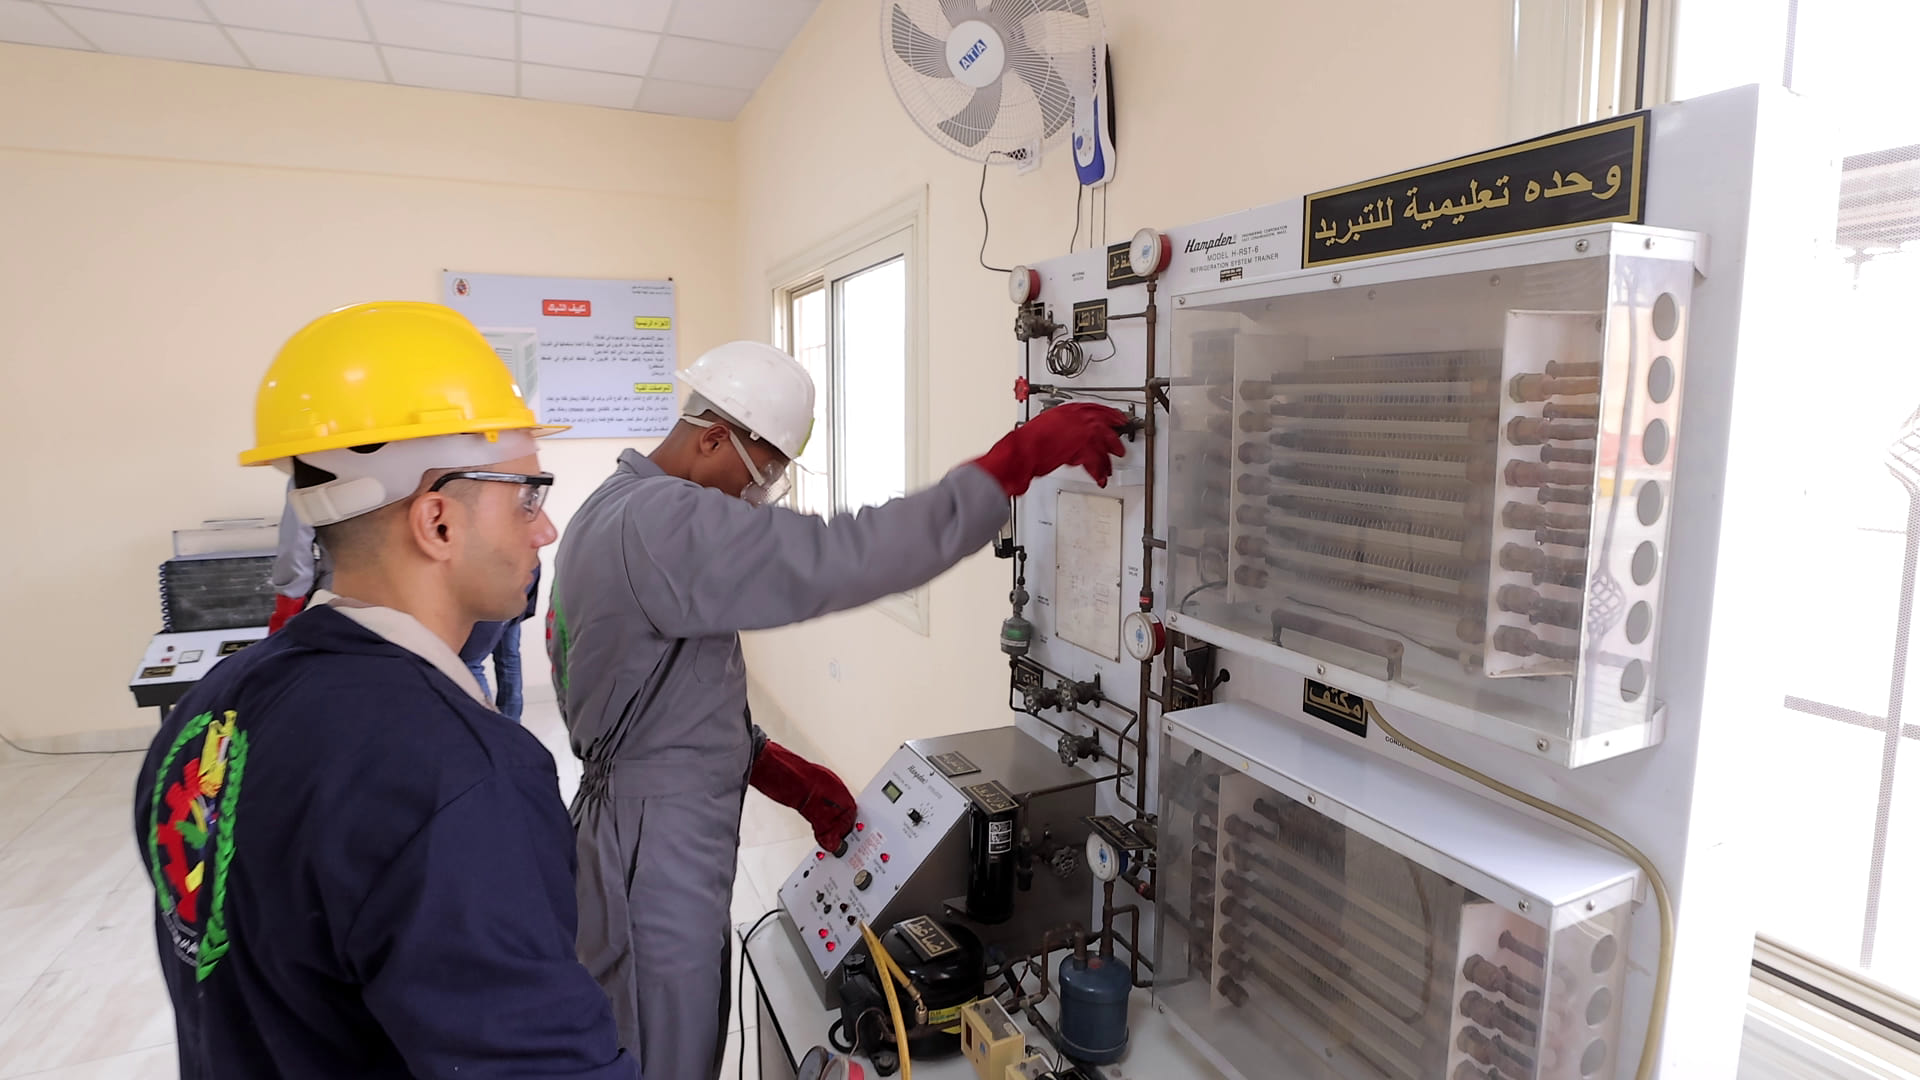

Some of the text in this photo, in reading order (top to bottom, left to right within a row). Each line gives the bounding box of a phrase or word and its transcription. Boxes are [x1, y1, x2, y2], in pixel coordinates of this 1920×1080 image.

[959, 39, 988, 71] ATA
[1315, 165, 1622, 247] وحده تعليمية للتبريد
[1184, 232, 1236, 255] Hampden
[1207, 245, 1259, 262] MODEL H-RST-6
[1190, 252, 1279, 273] REFRIGERATION SYSTEM TRAINER
[907, 920, 945, 953] ضاغط
